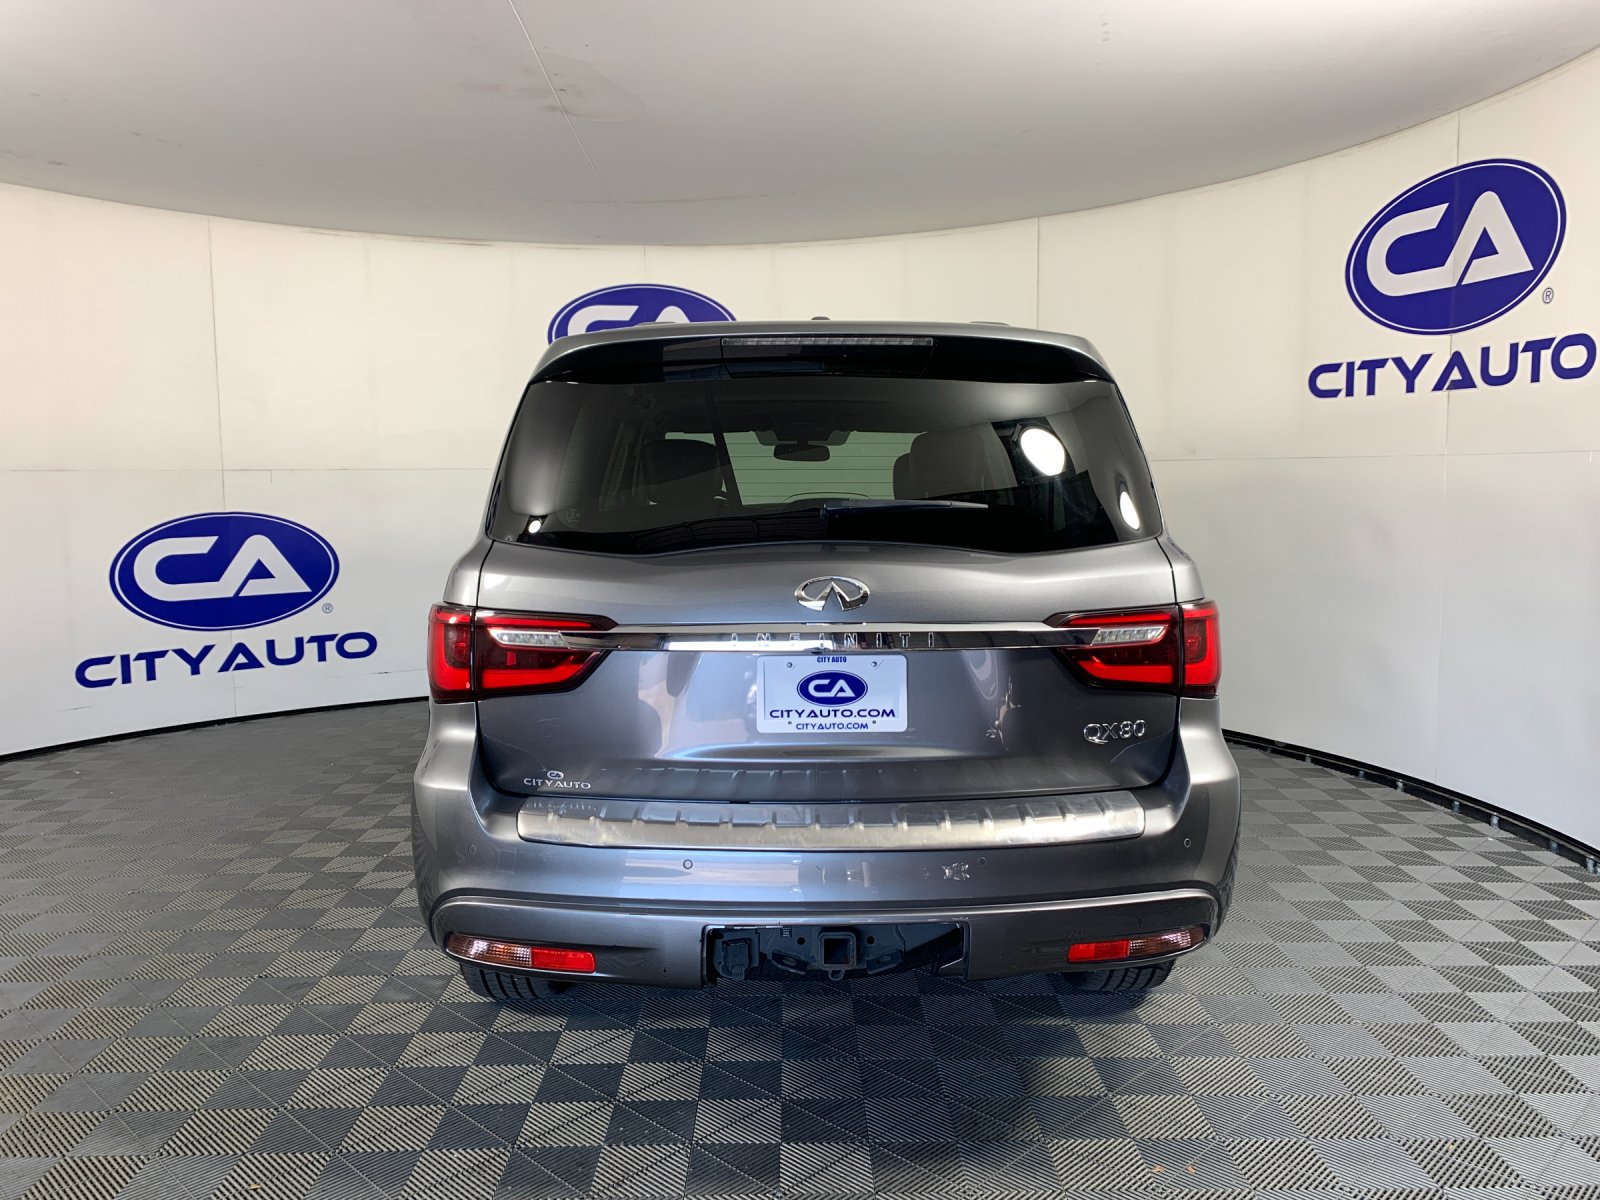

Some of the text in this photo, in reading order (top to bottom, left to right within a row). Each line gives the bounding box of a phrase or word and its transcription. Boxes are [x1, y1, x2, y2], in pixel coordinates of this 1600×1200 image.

[1366, 190, 1534, 297] CA
[133, 533, 313, 602] CA
[807, 679, 857, 698] CA
[769, 708, 896, 718] CITYAUTO.COM
[795, 722, 869, 730] CITYAUTO.COM
[1083, 719, 1147, 744] QX80
